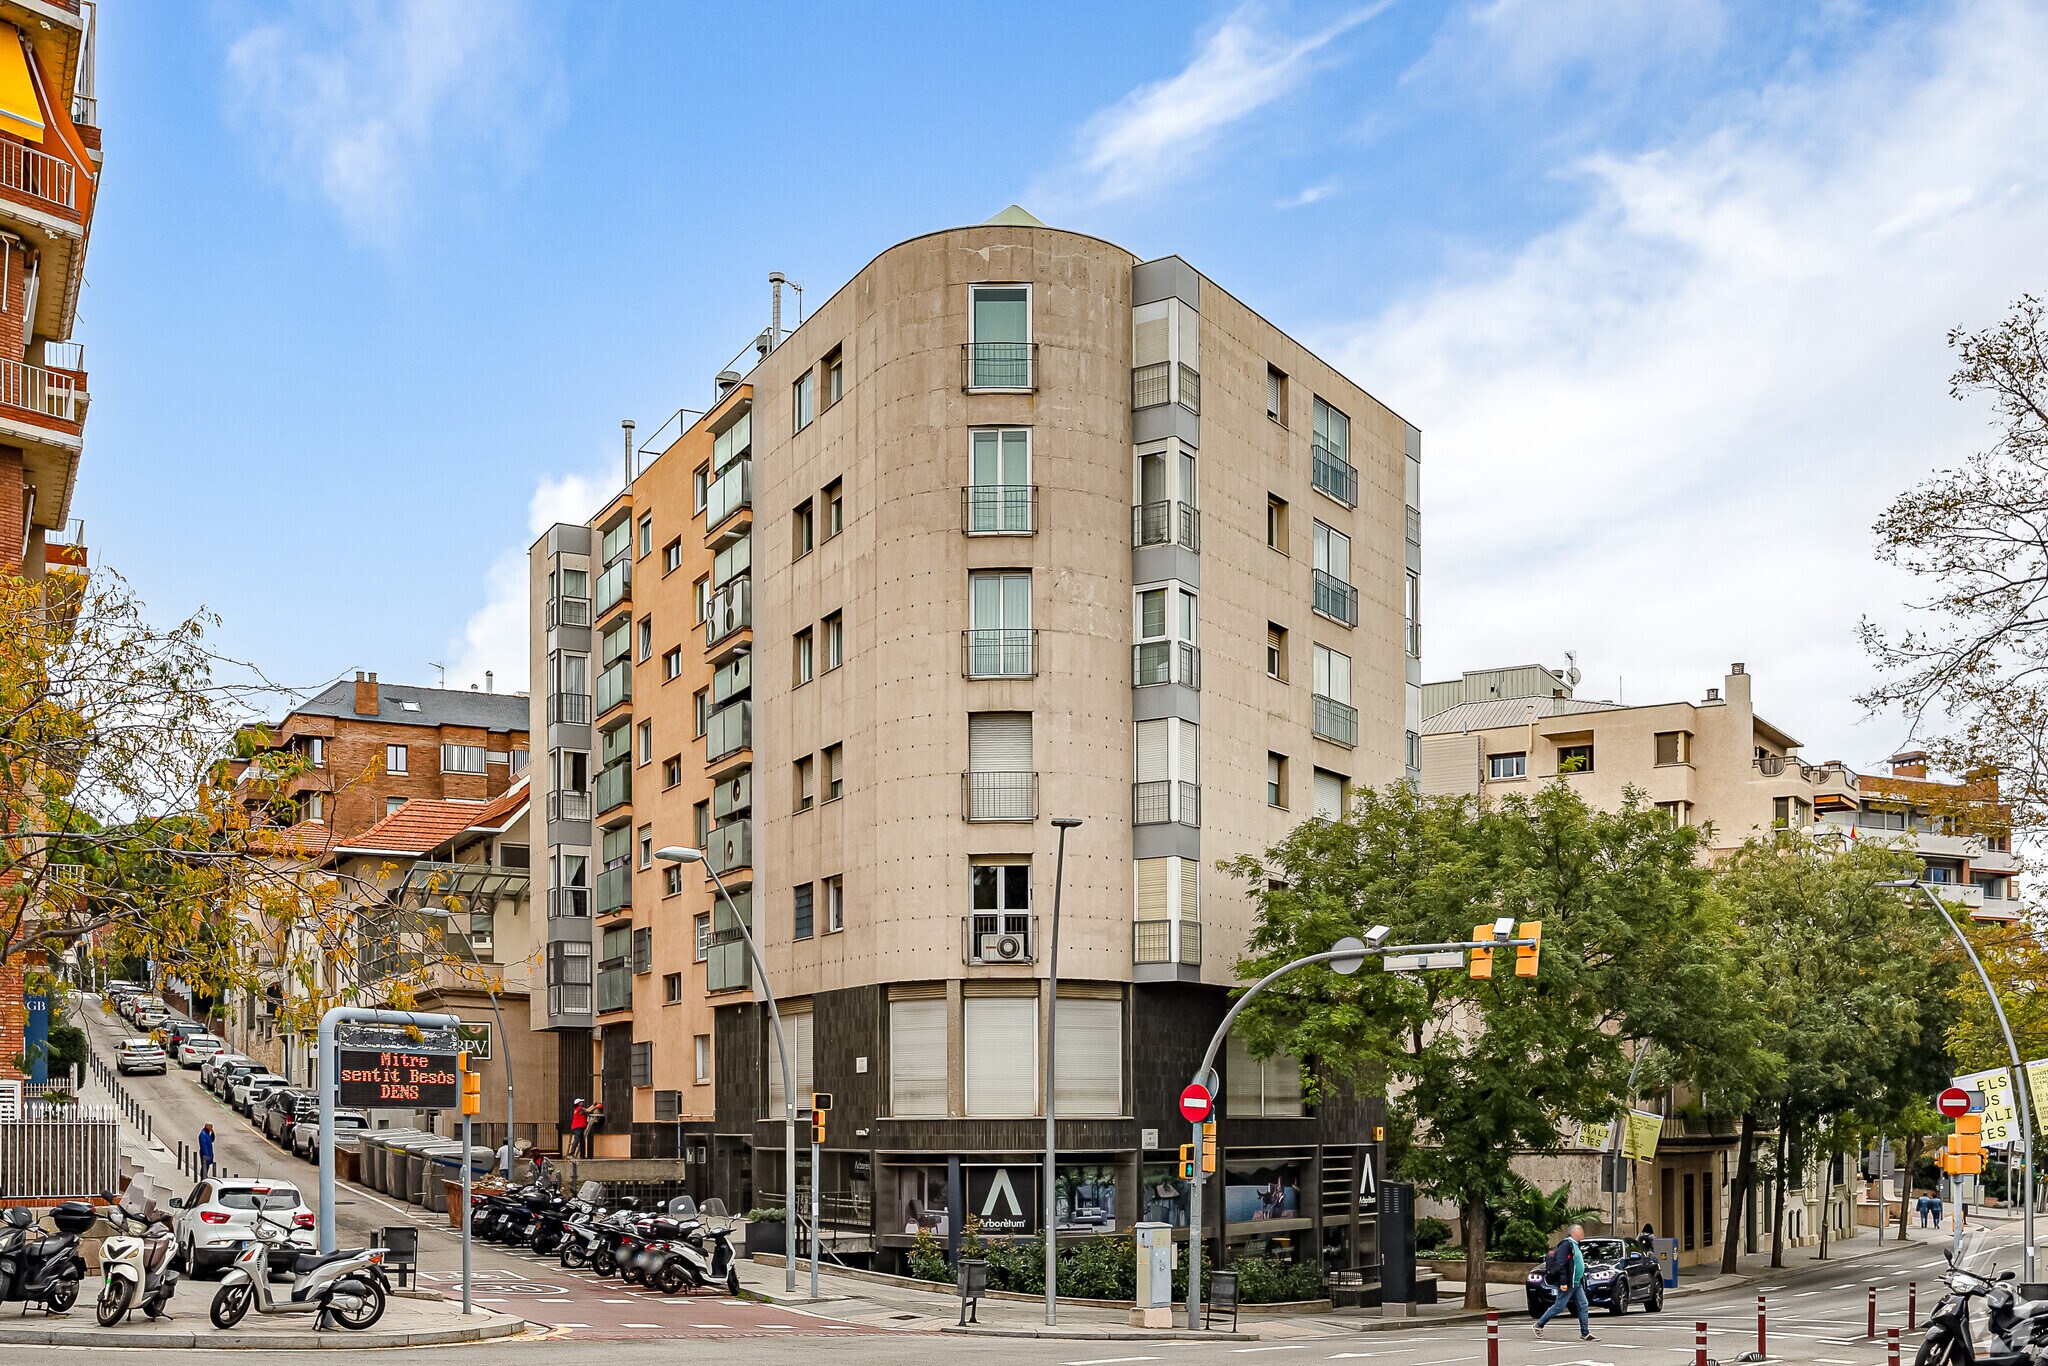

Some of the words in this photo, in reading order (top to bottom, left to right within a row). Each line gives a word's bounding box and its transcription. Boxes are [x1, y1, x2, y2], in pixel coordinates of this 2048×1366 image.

[380, 1052, 428, 1067] Mitre
[341, 1068, 401, 1082] sentit
[380, 1084, 419, 1099] DENS
[1977, 1076, 2007, 1092] ELS
[1984, 1107, 2012, 1124] ALI
[1581, 1123, 1609, 1139] REALI
[1980, 1126, 2007, 1140] TES
[1579, 1135, 1601, 1148] STES
